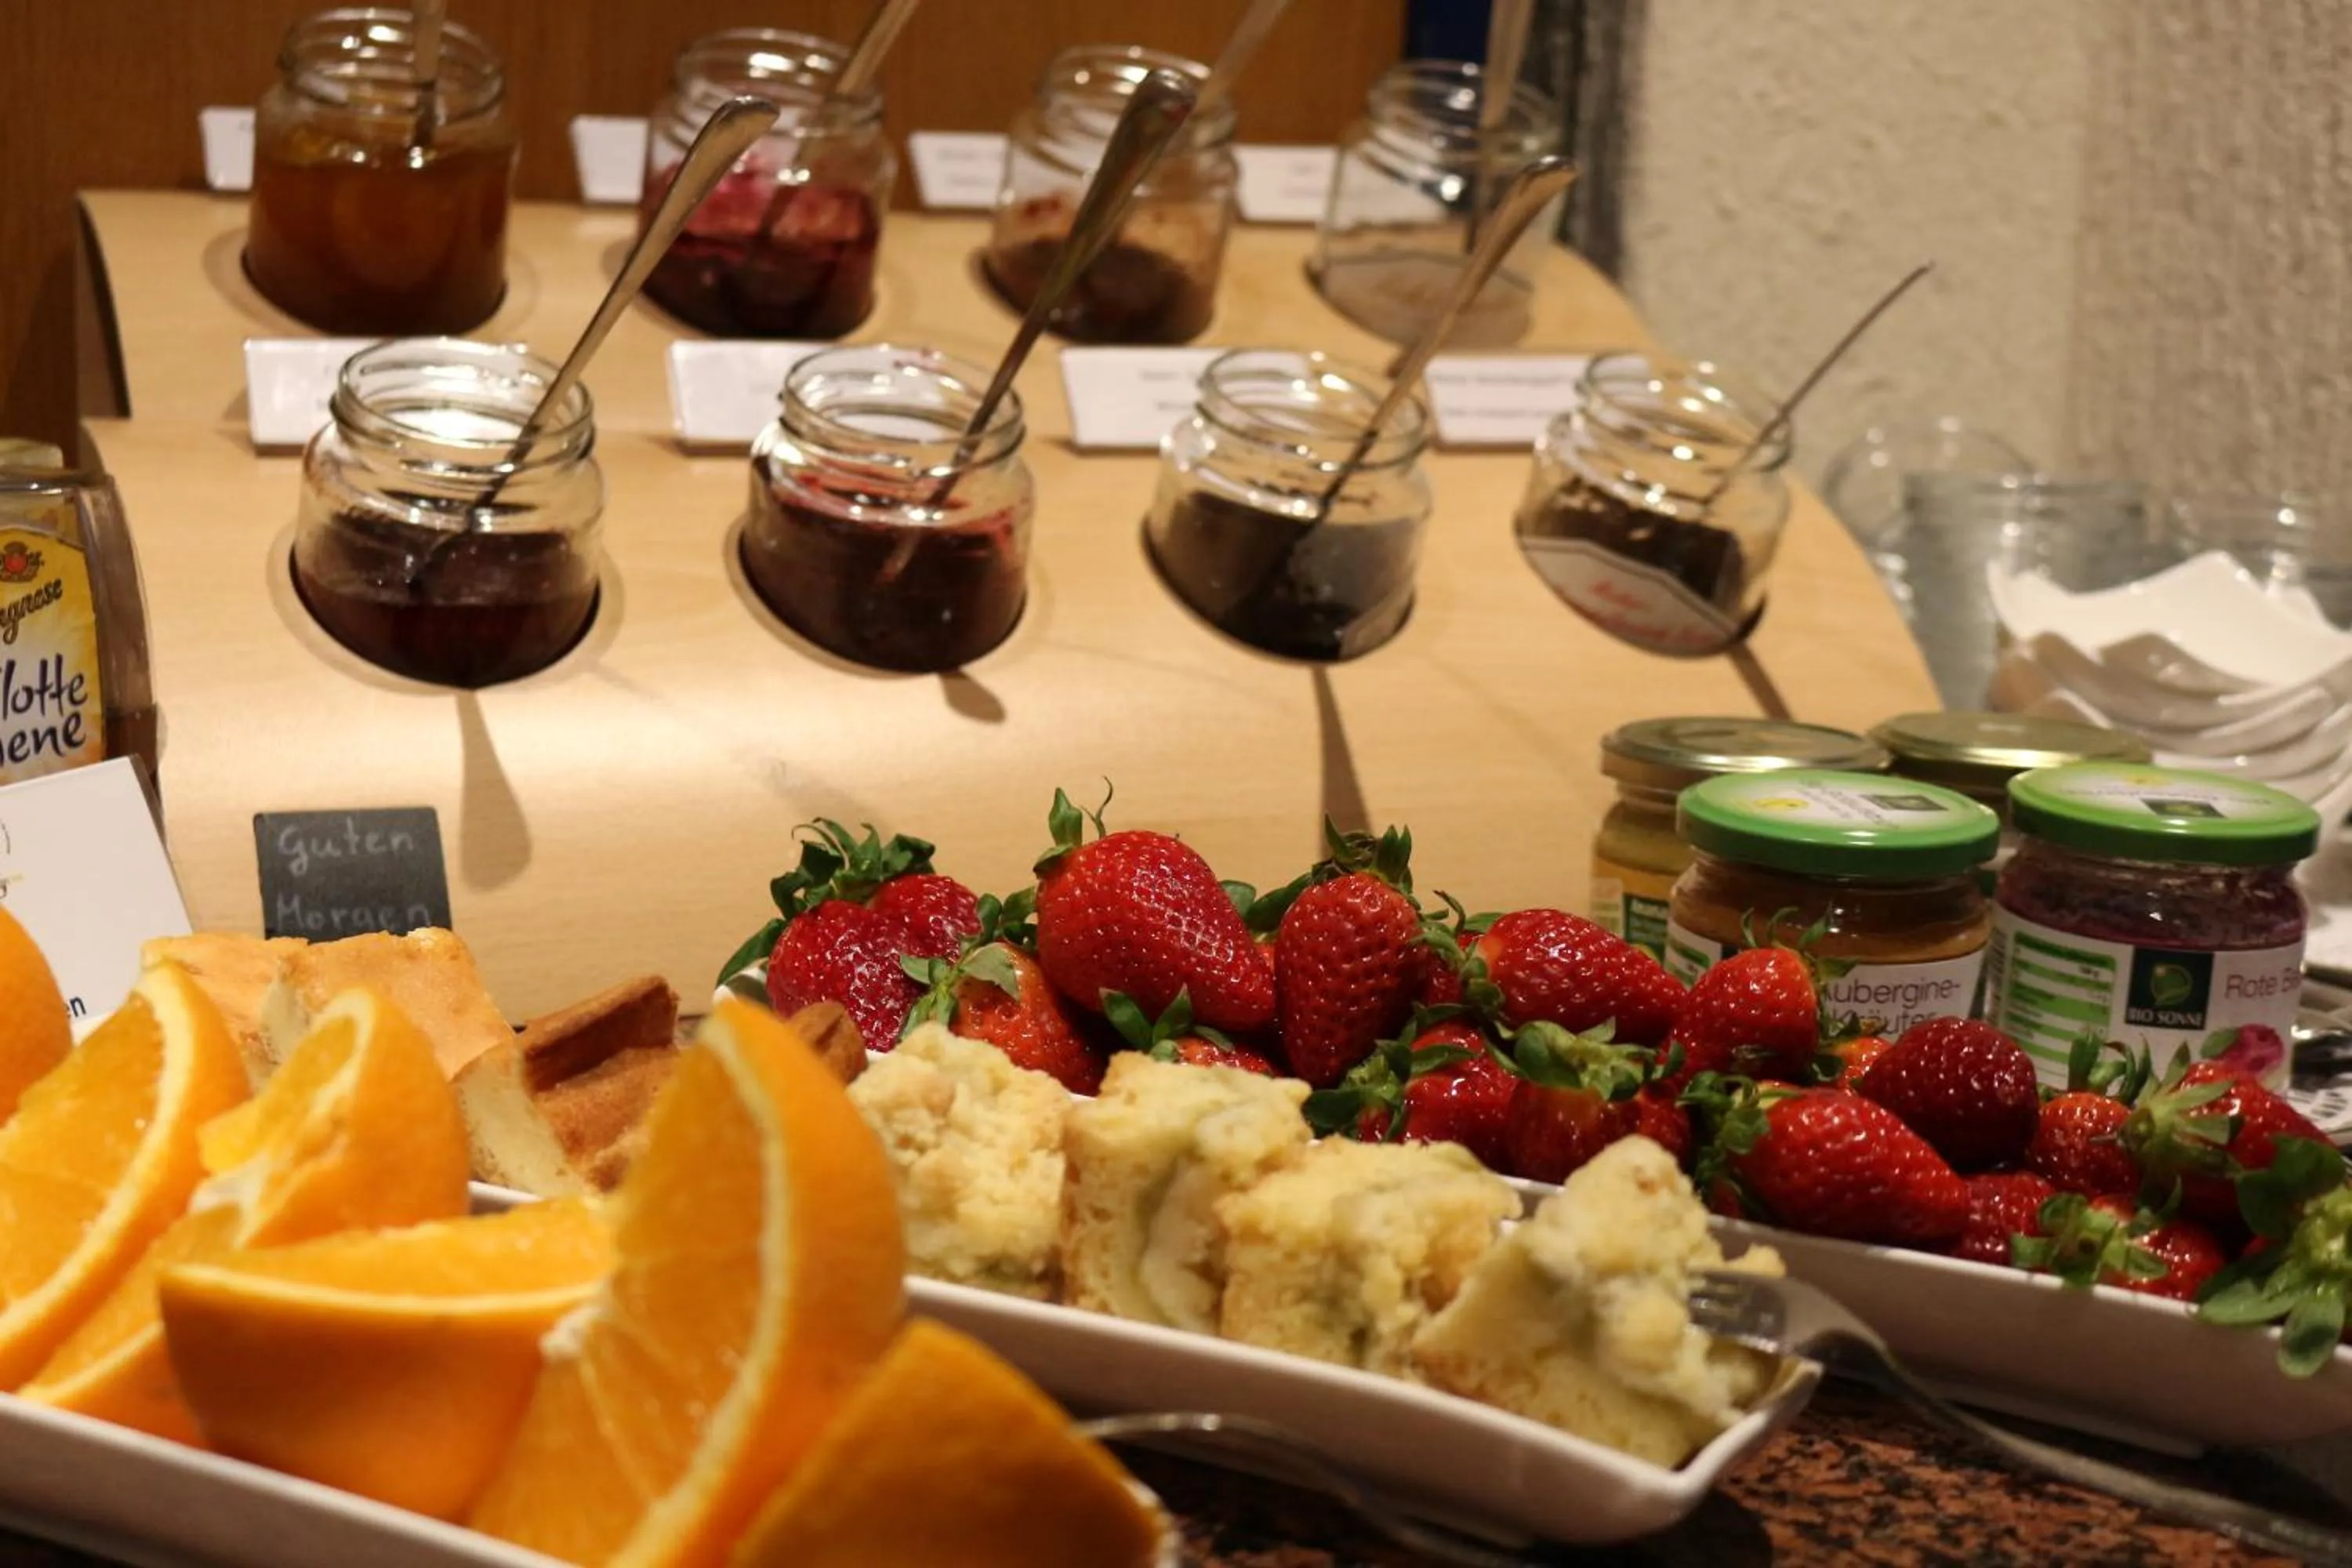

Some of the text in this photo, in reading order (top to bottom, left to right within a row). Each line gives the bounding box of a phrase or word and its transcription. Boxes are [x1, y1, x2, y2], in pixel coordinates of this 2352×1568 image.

[0, 653, 89, 722] lotte
[278, 816, 414, 878] Guten
[1827, 978, 1961, 1010] ubergine-
[2224, 975, 2278, 999] Rote
[2128, 1007, 2204, 1027] BIO SONNE
